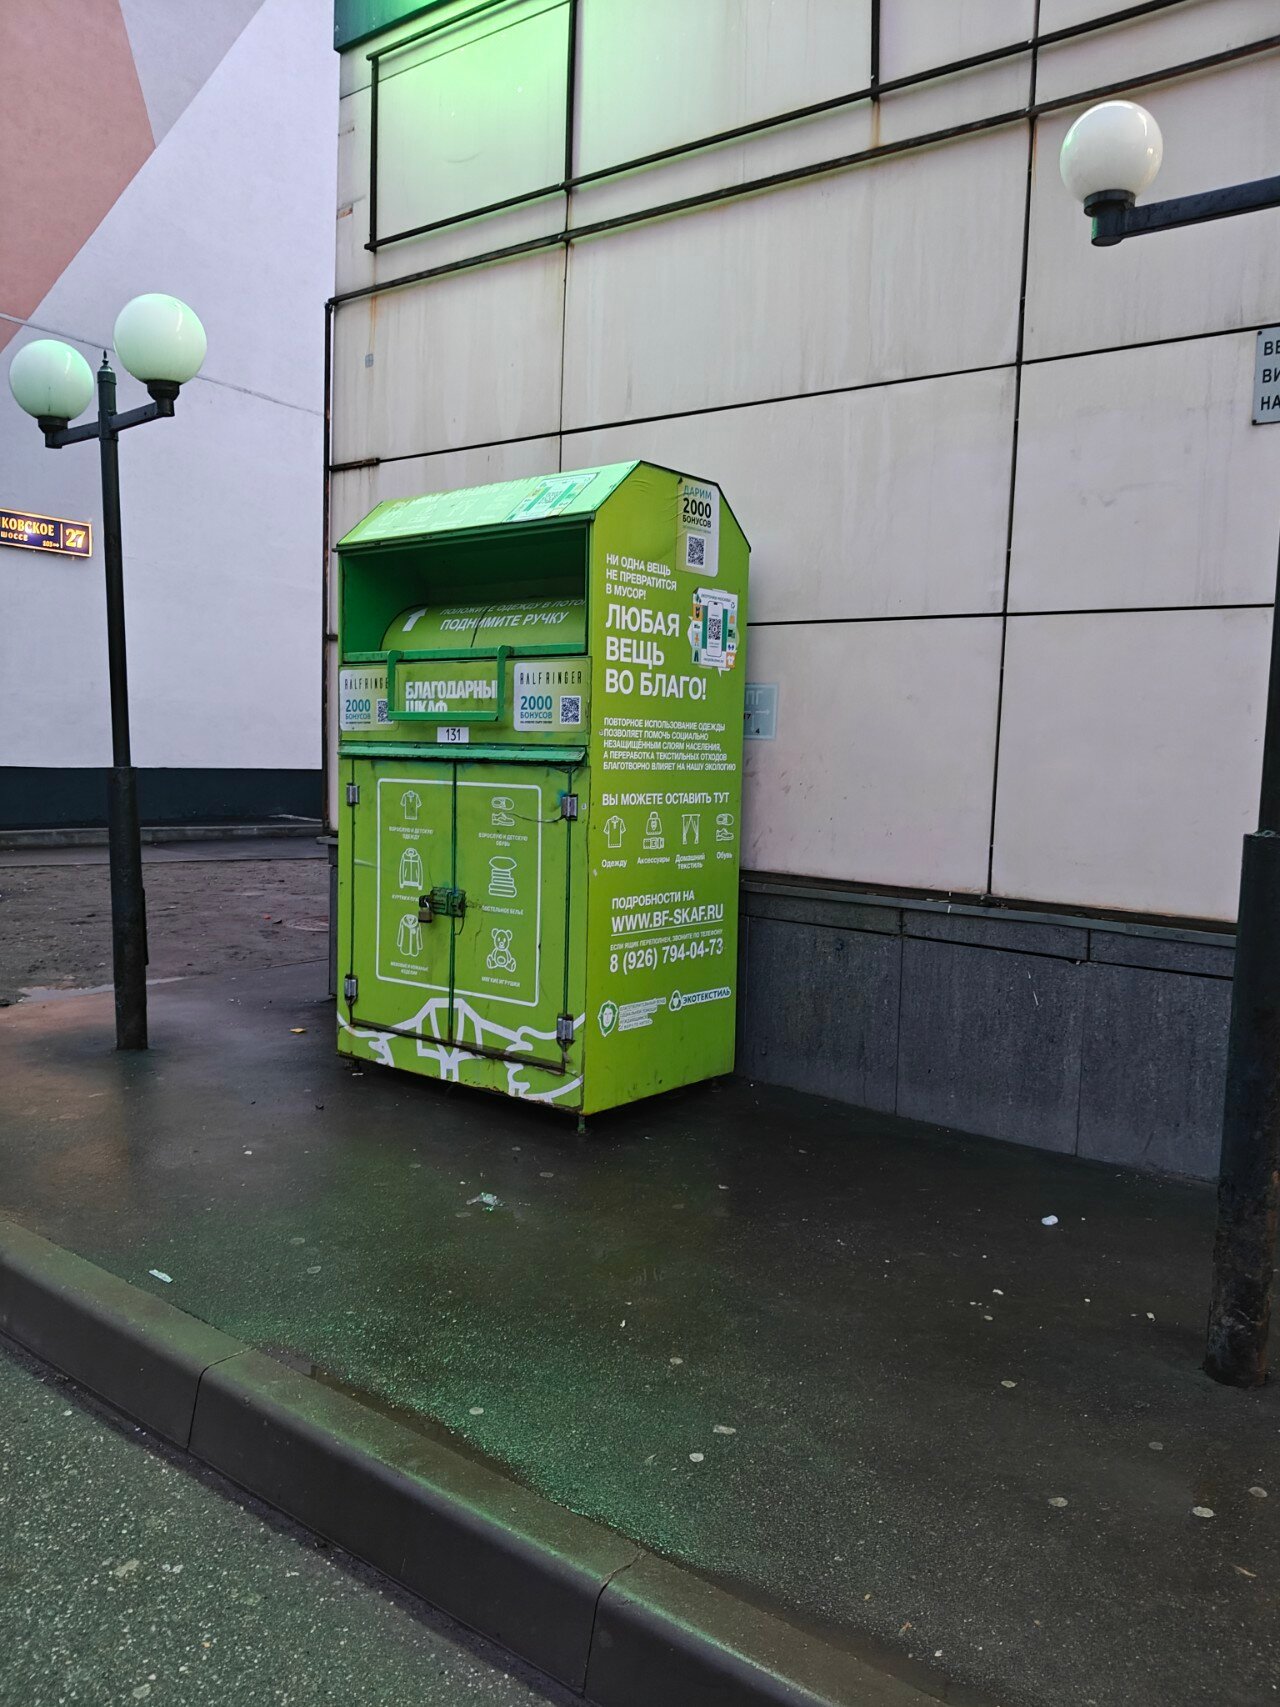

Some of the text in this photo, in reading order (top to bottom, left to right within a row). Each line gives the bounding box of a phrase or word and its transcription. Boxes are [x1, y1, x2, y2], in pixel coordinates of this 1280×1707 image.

[683, 485, 712, 500] ДАРИМ
[683, 497, 712, 519] 2000
[0, 516, 55, 537] КОВСКОЕ
[683, 514, 711, 528] БОНУСОВ
[65, 528, 86, 549] 27
[606, 553, 671, 577] НИ ОДНА ВЕЩЬ
[606, 568, 677, 591] НЕ ПРЕВРАТИТСЯ
[605, 583, 647, 601] В МУСОР!
[440, 611, 569, 632] ПОДНИМИТЕ РУЧКУ
[605, 603, 680, 637] ЛЮБАЯ
[606, 636, 665, 670] ВЕЩЬ
[405, 679, 498, 700] БЛАГОДАРНЫ
[605, 668, 707, 700] ВО БЛАГО!
[345, 699, 371, 713] 2000
[520, 695, 553, 711] 2000
[520, 711, 553, 719] БОНУСОВ
[604, 717, 726, 732] ПОВТОРНОЕ ИСПОЛЬЗОВАНИЕ ОДЕЖДЫ
[445, 728, 461, 741] 131
[603, 728, 709, 741] ПОЗВОЛЯЕТ ПОМОЧЬ СОЦИАЛЬНО
[662, 741, 684, 750] СЛОЯМ
[603, 750, 728, 763] А ПЕРЕРАБОТКА ТЕКСТИЛЬНЫХ ОТХОДОВ
[603, 761, 736, 771] БЛАГОТВОРНО ВЛИЯЕТ НА НАШУ ЭКОЛОГИЮ
[602, 792, 730, 806] ВЫ МОЖЕТЕ ОСТАВИТЬ ТУТ
[601, 859, 628, 868] Одежду
[611, 890, 695, 910] ПОДРОБНОСТИ НА
[611, 903, 724, 933] WWW.BF-SKAF.RU
[610, 937, 724, 975] 8 (926) 794-04-73
[682, 987, 731, 1005] ЭКОТЕКСТИЛЬ
